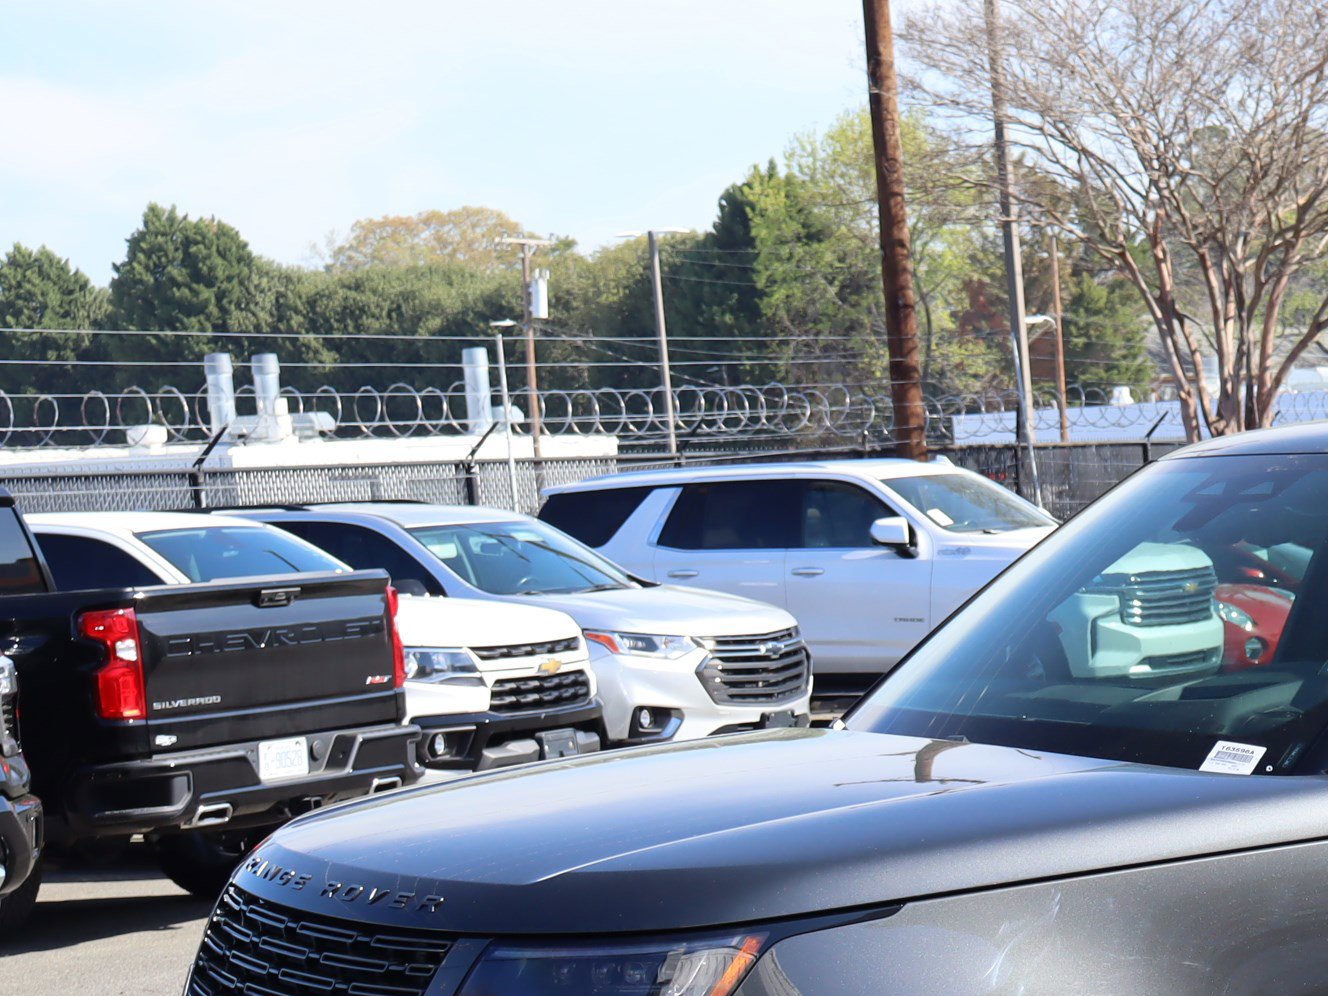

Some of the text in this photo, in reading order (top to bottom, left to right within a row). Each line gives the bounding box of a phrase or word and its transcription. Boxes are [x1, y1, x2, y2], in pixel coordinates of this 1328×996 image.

[167, 620, 381, 657] CHEVROLET
[153, 695, 221, 710] SILVERADO
[245, 857, 444, 912] RANGE ROVER
